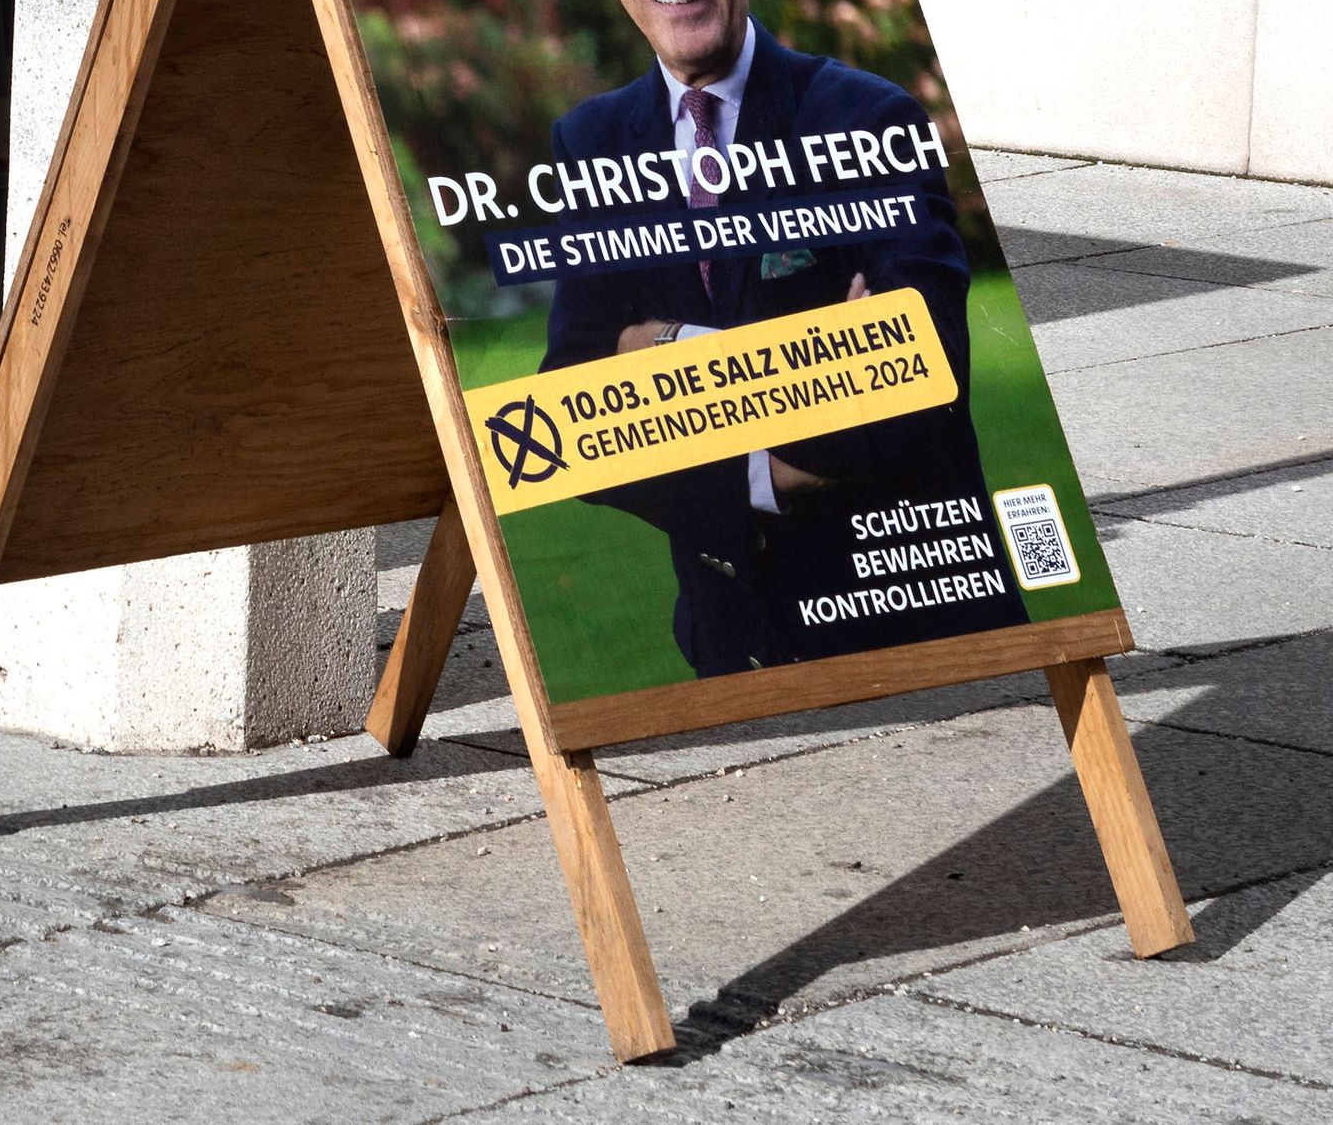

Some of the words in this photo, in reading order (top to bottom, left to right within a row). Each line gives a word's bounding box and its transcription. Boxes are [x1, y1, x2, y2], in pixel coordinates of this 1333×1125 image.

[427, 171, 519, 226] DR.
[527, 139, 796, 213] CHRISTOPH
[800, 121, 949, 183] FERCH
[499, 238, 556, 274] DIE
[560, 222, 690, 266] STIMME
[693, 215, 757, 250] DER
[757, 195, 917, 242] VERNUNFT
[560, 380, 650, 423] 10.03.
[652, 365, 705, 402] DIE
[707, 347, 778, 389] SALZ
[779, 313, 916, 370] WÄHLEN!
[577, 375, 864, 461] GEMEINDERATSWAHL
[864, 353, 929, 390] 2024
[851, 496, 983, 540] SCHÜTZEN
[1003, 497, 1022, 508] HIER
[1023, 494, 1047, 505] MEHR
[1007, 506, 1051, 520] ERFAHREN:
[852, 533, 994, 578] BEWAHREN
[798, 569, 1006, 625] KONTROLLIEREN
